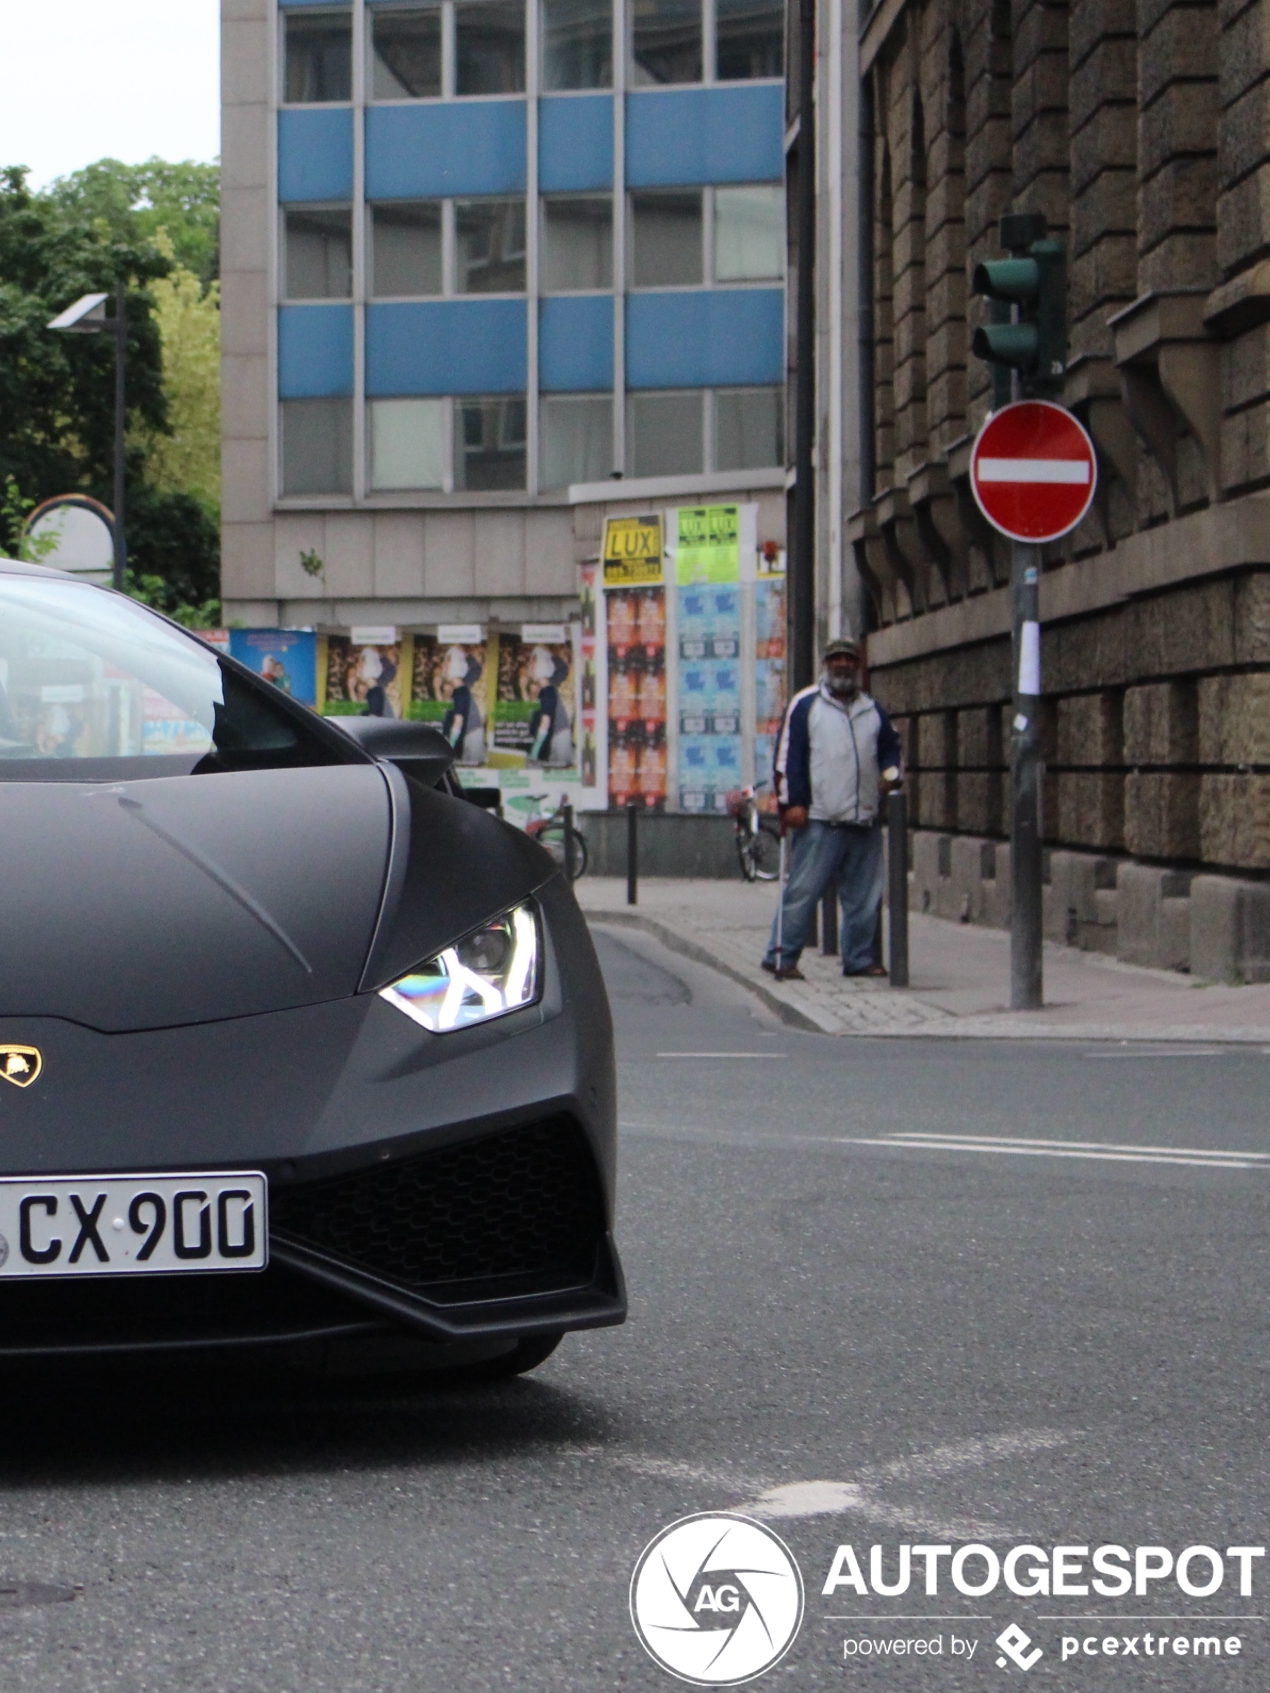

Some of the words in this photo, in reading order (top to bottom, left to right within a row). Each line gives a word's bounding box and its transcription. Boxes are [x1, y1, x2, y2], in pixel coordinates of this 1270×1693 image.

[611, 531, 651, 557] LUX
[19, 1193, 111, 1265] CX
[129, 1189, 256, 1261] 900
